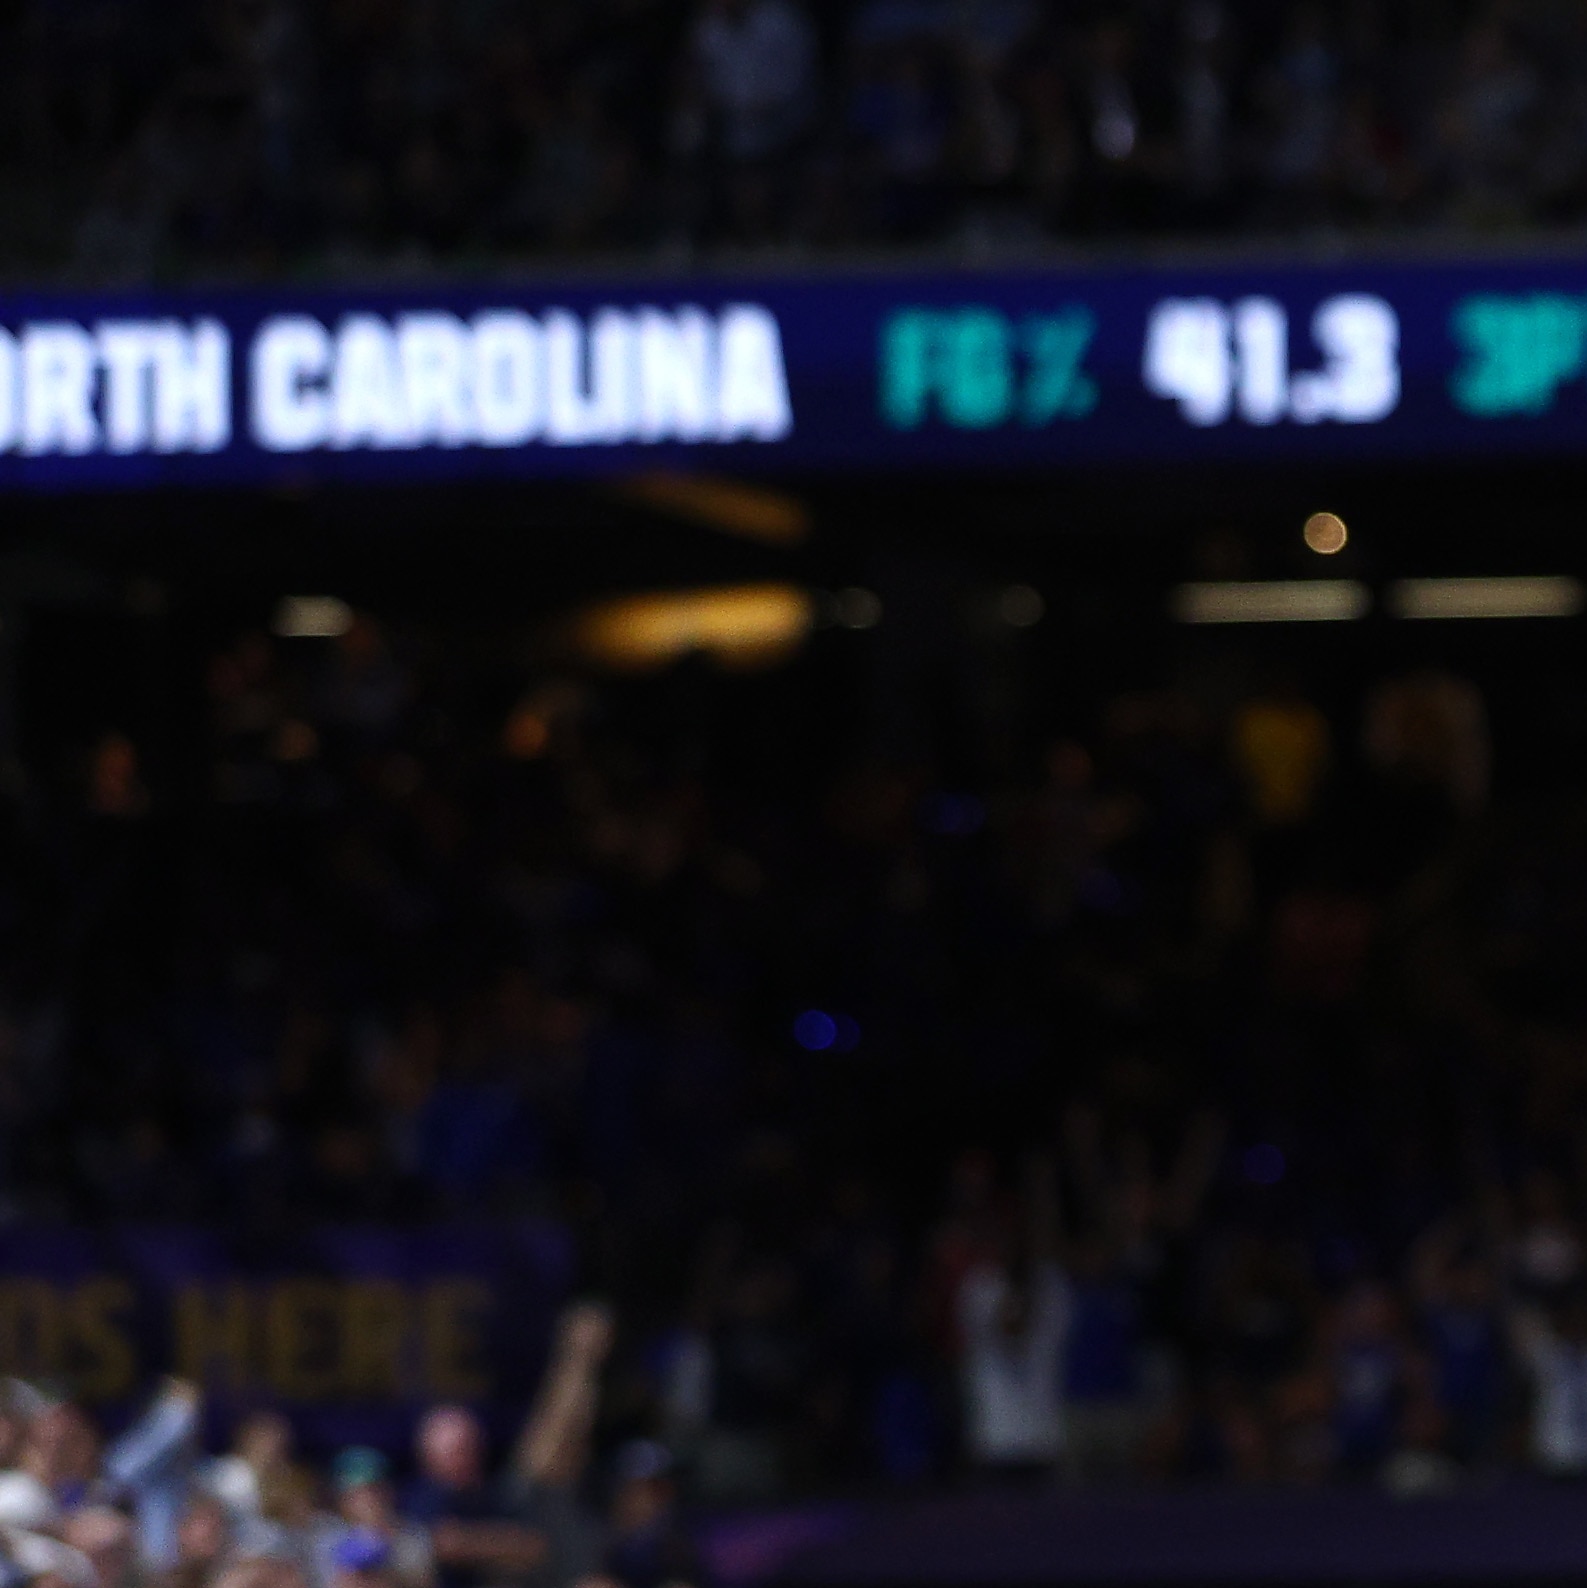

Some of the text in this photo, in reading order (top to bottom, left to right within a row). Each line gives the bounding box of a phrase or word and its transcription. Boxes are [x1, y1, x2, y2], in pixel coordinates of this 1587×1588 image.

[250, 306, 791, 450] CAROLINA
[1145, 294, 1398, 424] 41.3
[172, 1276, 492, 1395] HERE
